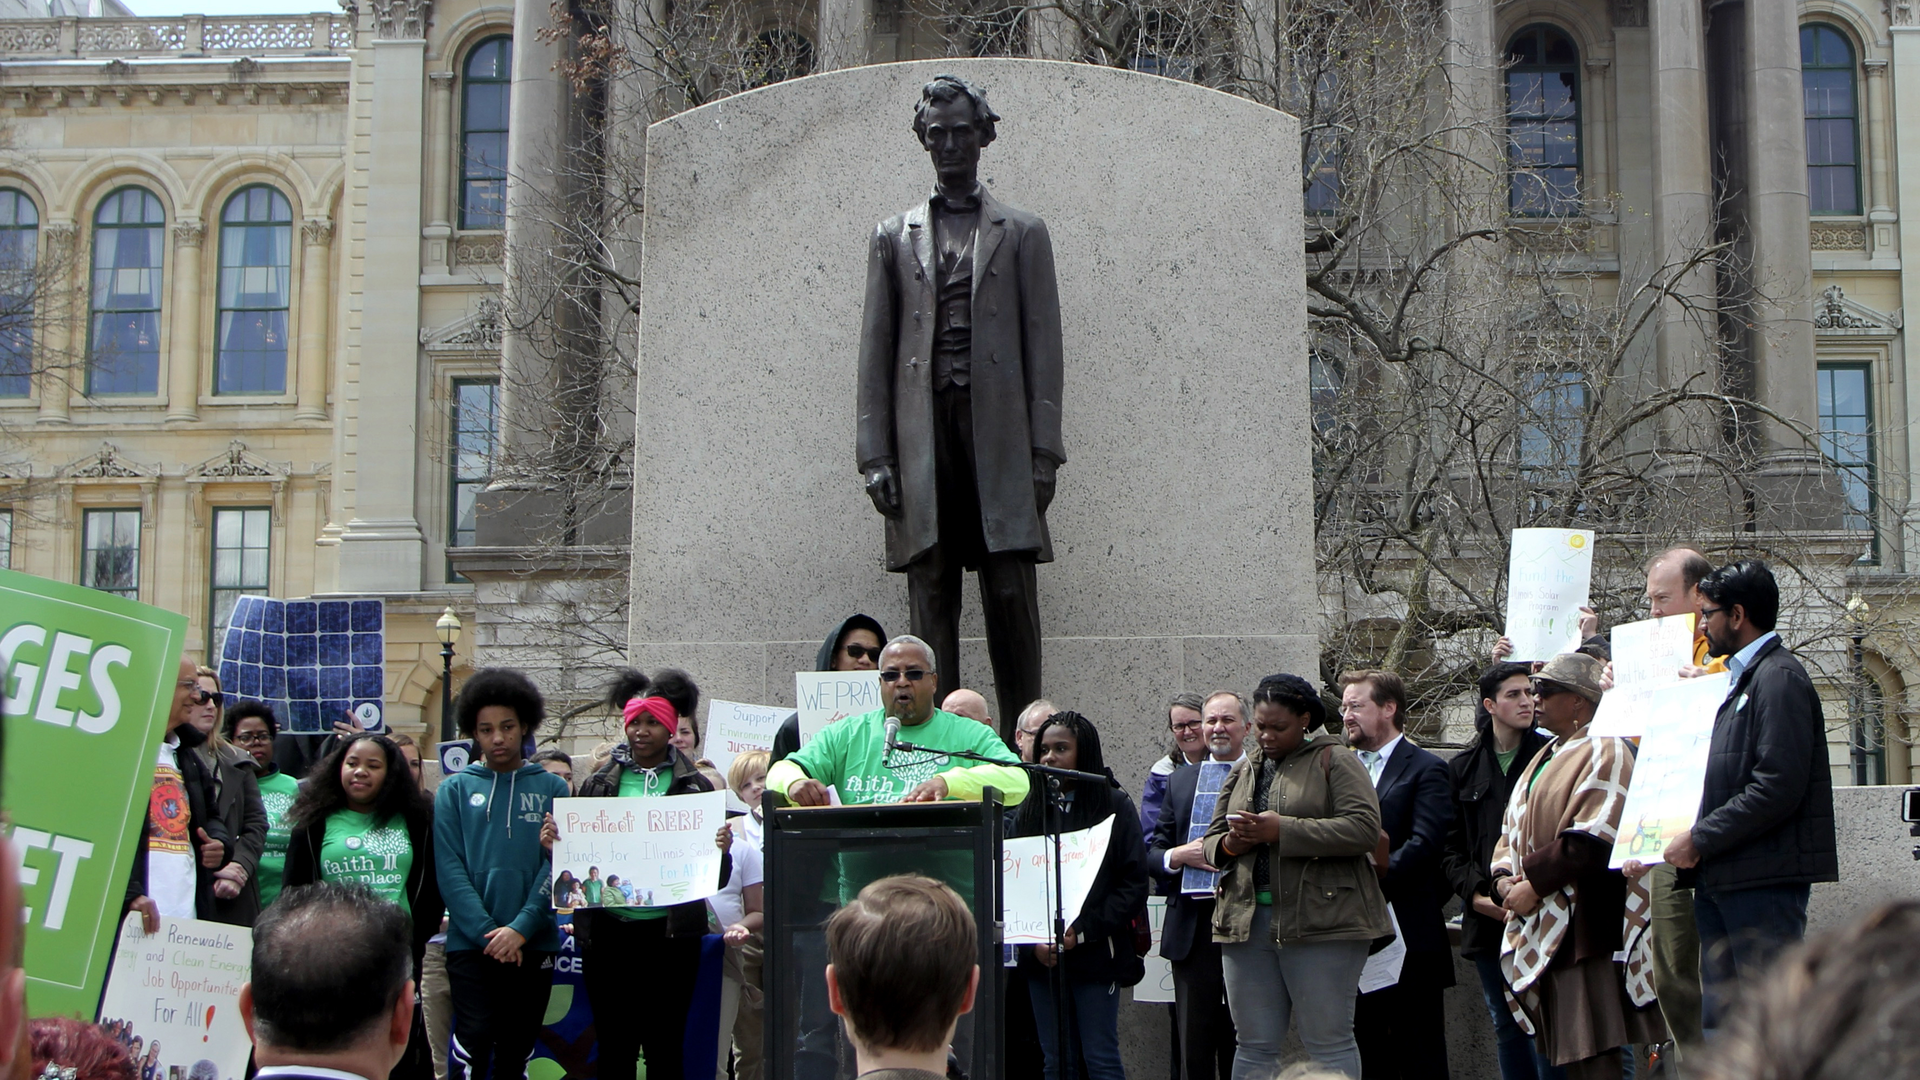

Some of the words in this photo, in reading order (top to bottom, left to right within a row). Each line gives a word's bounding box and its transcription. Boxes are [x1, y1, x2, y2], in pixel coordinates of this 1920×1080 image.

[1556, 569, 1574, 585] the
[1538, 586, 1560, 600] Solar
[1528, 600, 1560, 615] Program
[801, 681, 832, 711] WE
[835, 681, 881, 709] PRAY
[733, 705, 777, 727] Support
[845, 775, 893, 793] faith
[520, 792, 547, 813] NY
[855, 792, 870, 803] in
[567, 809, 635, 833] Protect
[648, 809, 703, 833] RERF
[563, 841, 602, 865] funds
[609, 841, 628, 863] for
[643, 841, 684, 860] Illinois
[689, 843, 715, 858] Solar
[324, 855, 376, 875] faith
[660, 864, 677, 880] For
[360, 872, 402, 886] place
[168, 923, 234, 951] Renewable
[146, 948, 165, 963] and
[172, 950, 204, 967] Clean
[209, 953, 251, 982] Energy
[143, 967, 165, 987] Job
[171, 971, 238, 998] Opportunitie
[154, 997, 178, 1024] For
